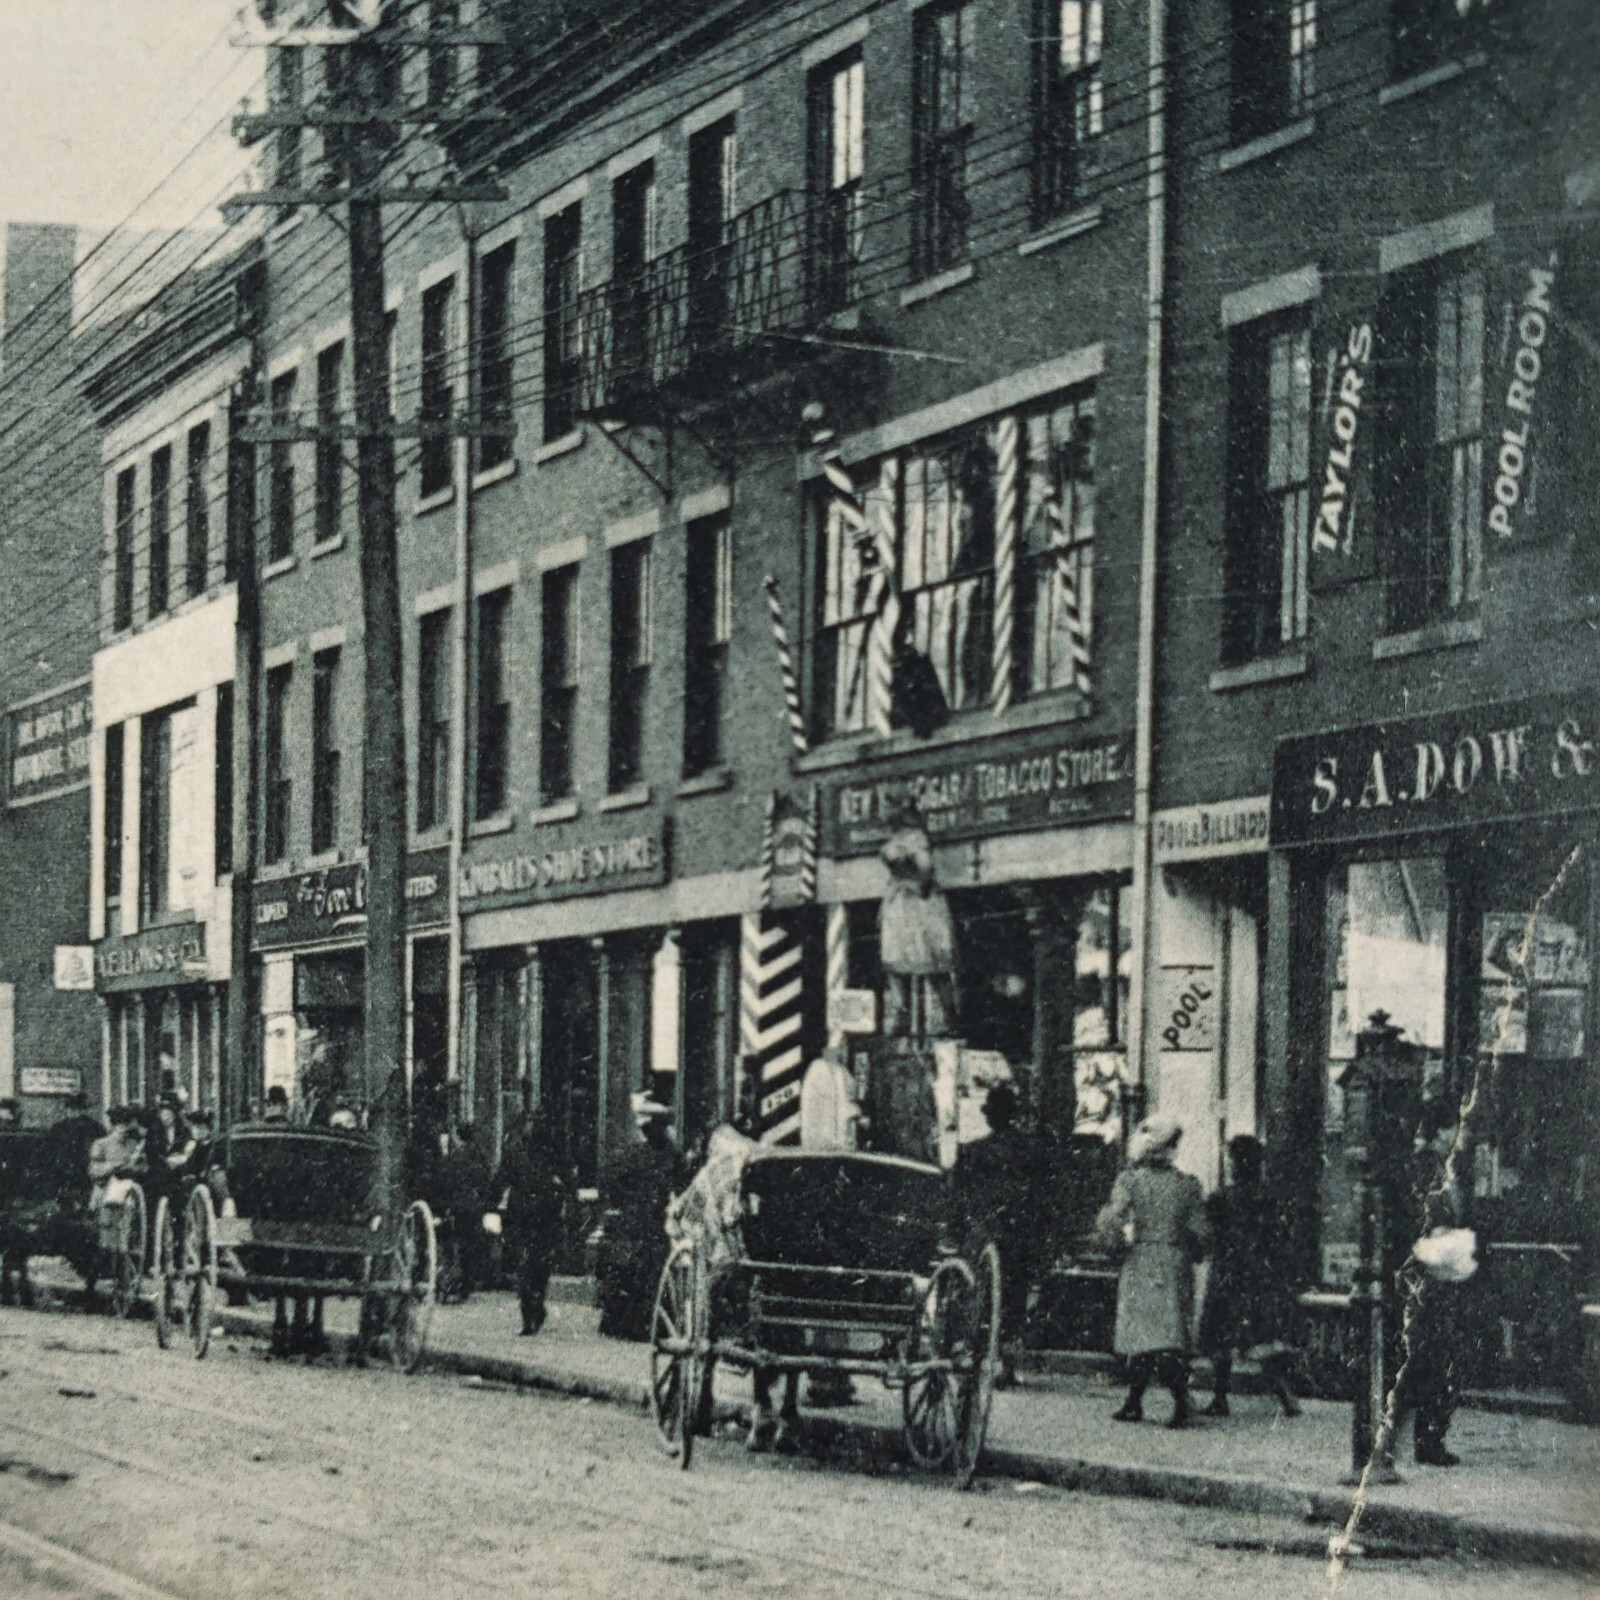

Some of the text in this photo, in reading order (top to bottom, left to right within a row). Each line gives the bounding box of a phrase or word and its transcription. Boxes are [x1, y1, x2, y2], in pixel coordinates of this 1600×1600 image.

[1313, 323, 1372, 552] TAYLOR'S
[1488, 422, 1530, 538] POOL
[974, 755, 1050, 802] TOBACCO
[1055, 743, 1122, 789] STORE
[1552, 719, 1594, 780] &
[1162, 977, 1214, 1050] POOL
